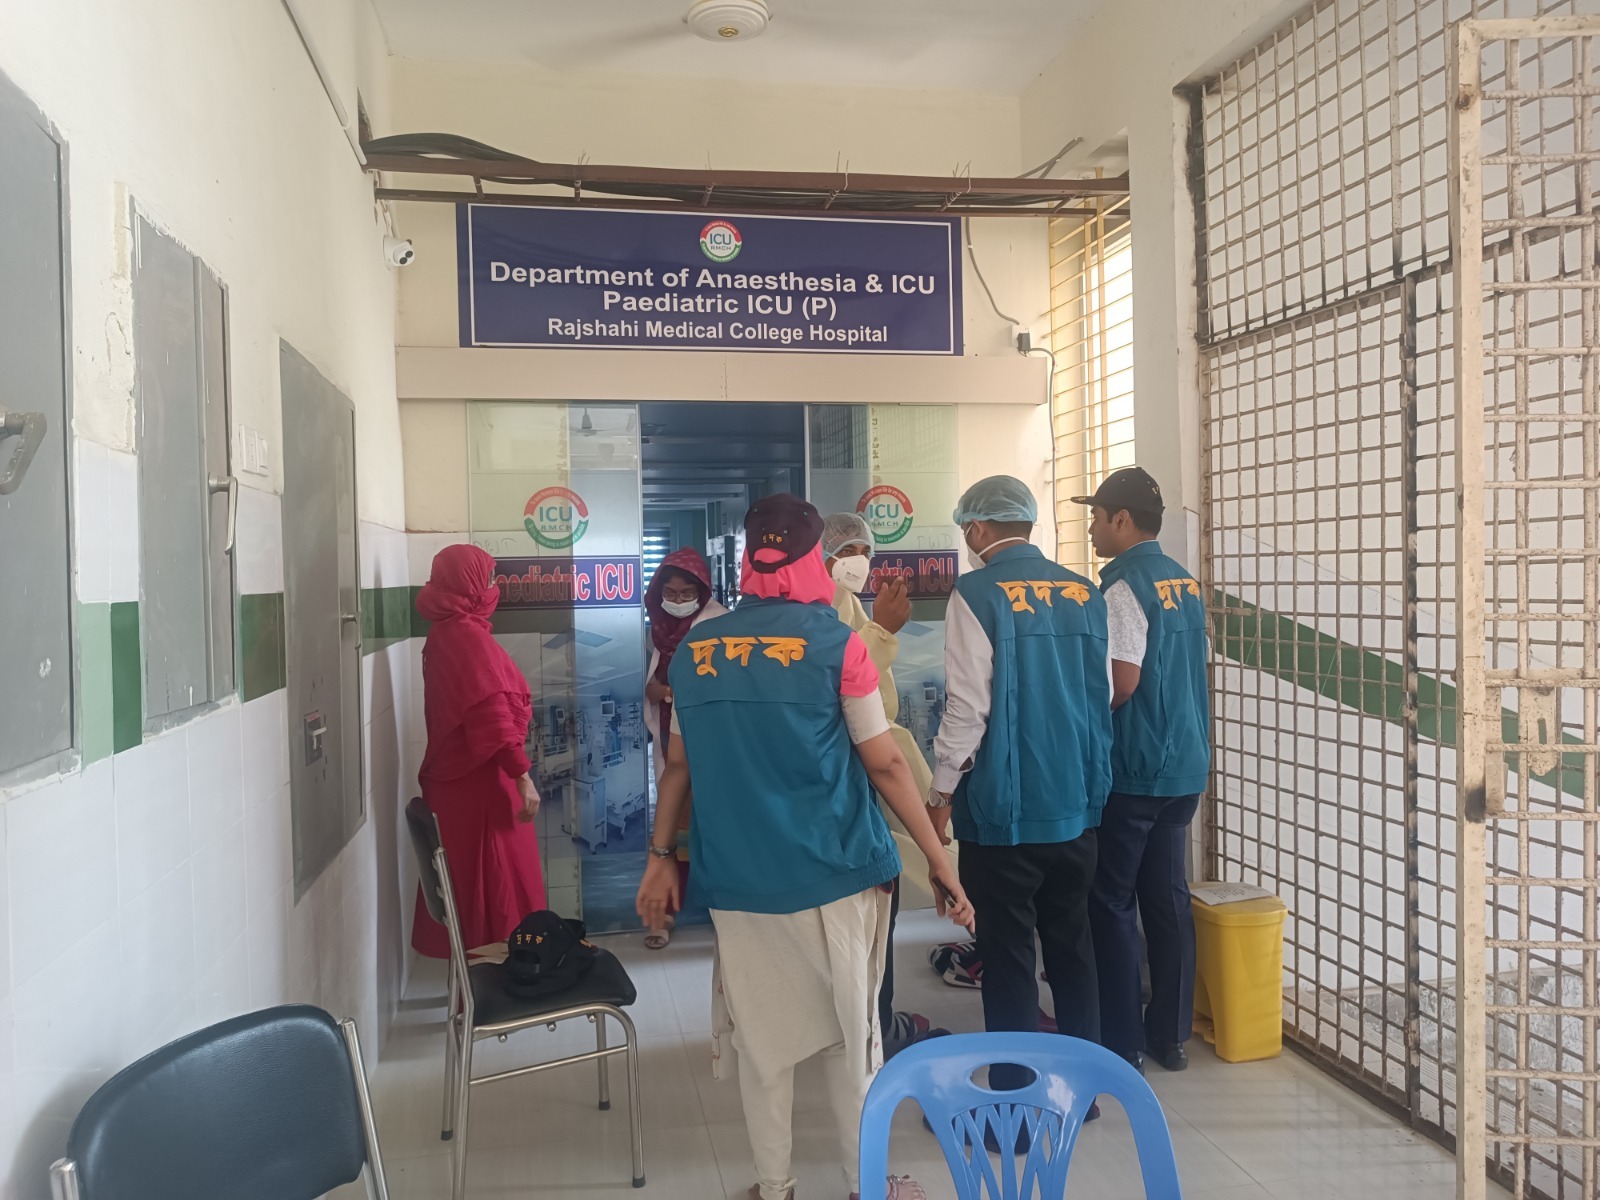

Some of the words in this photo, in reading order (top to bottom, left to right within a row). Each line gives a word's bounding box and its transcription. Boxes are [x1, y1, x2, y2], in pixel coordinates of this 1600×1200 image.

[709, 233, 732, 245] ICU
[490, 261, 654, 288] Department
[662, 268, 690, 288] of
[695, 268, 857, 293] Anaesthesia
[865, 273, 884, 293] &
[892, 274, 935, 295] ICU
[603, 290, 739, 314] Paediatric
[747, 294, 793, 315] ICU
[802, 296, 837, 321] (P)
[548, 317, 639, 340] Rajshahi
[645, 320, 723, 339] Medical
[729, 322, 804, 345] College
[809, 324, 888, 346] Hospital
[539, 506, 573, 522] ICU
[869, 503, 899, 518] ICU
[496, 565, 590, 602] aediatric
[594, 563, 634, 600] ICU
[918, 557, 954, 592] ICU
[996, 580, 1090, 614] দুদক
[688, 636, 808, 677] দুদক
